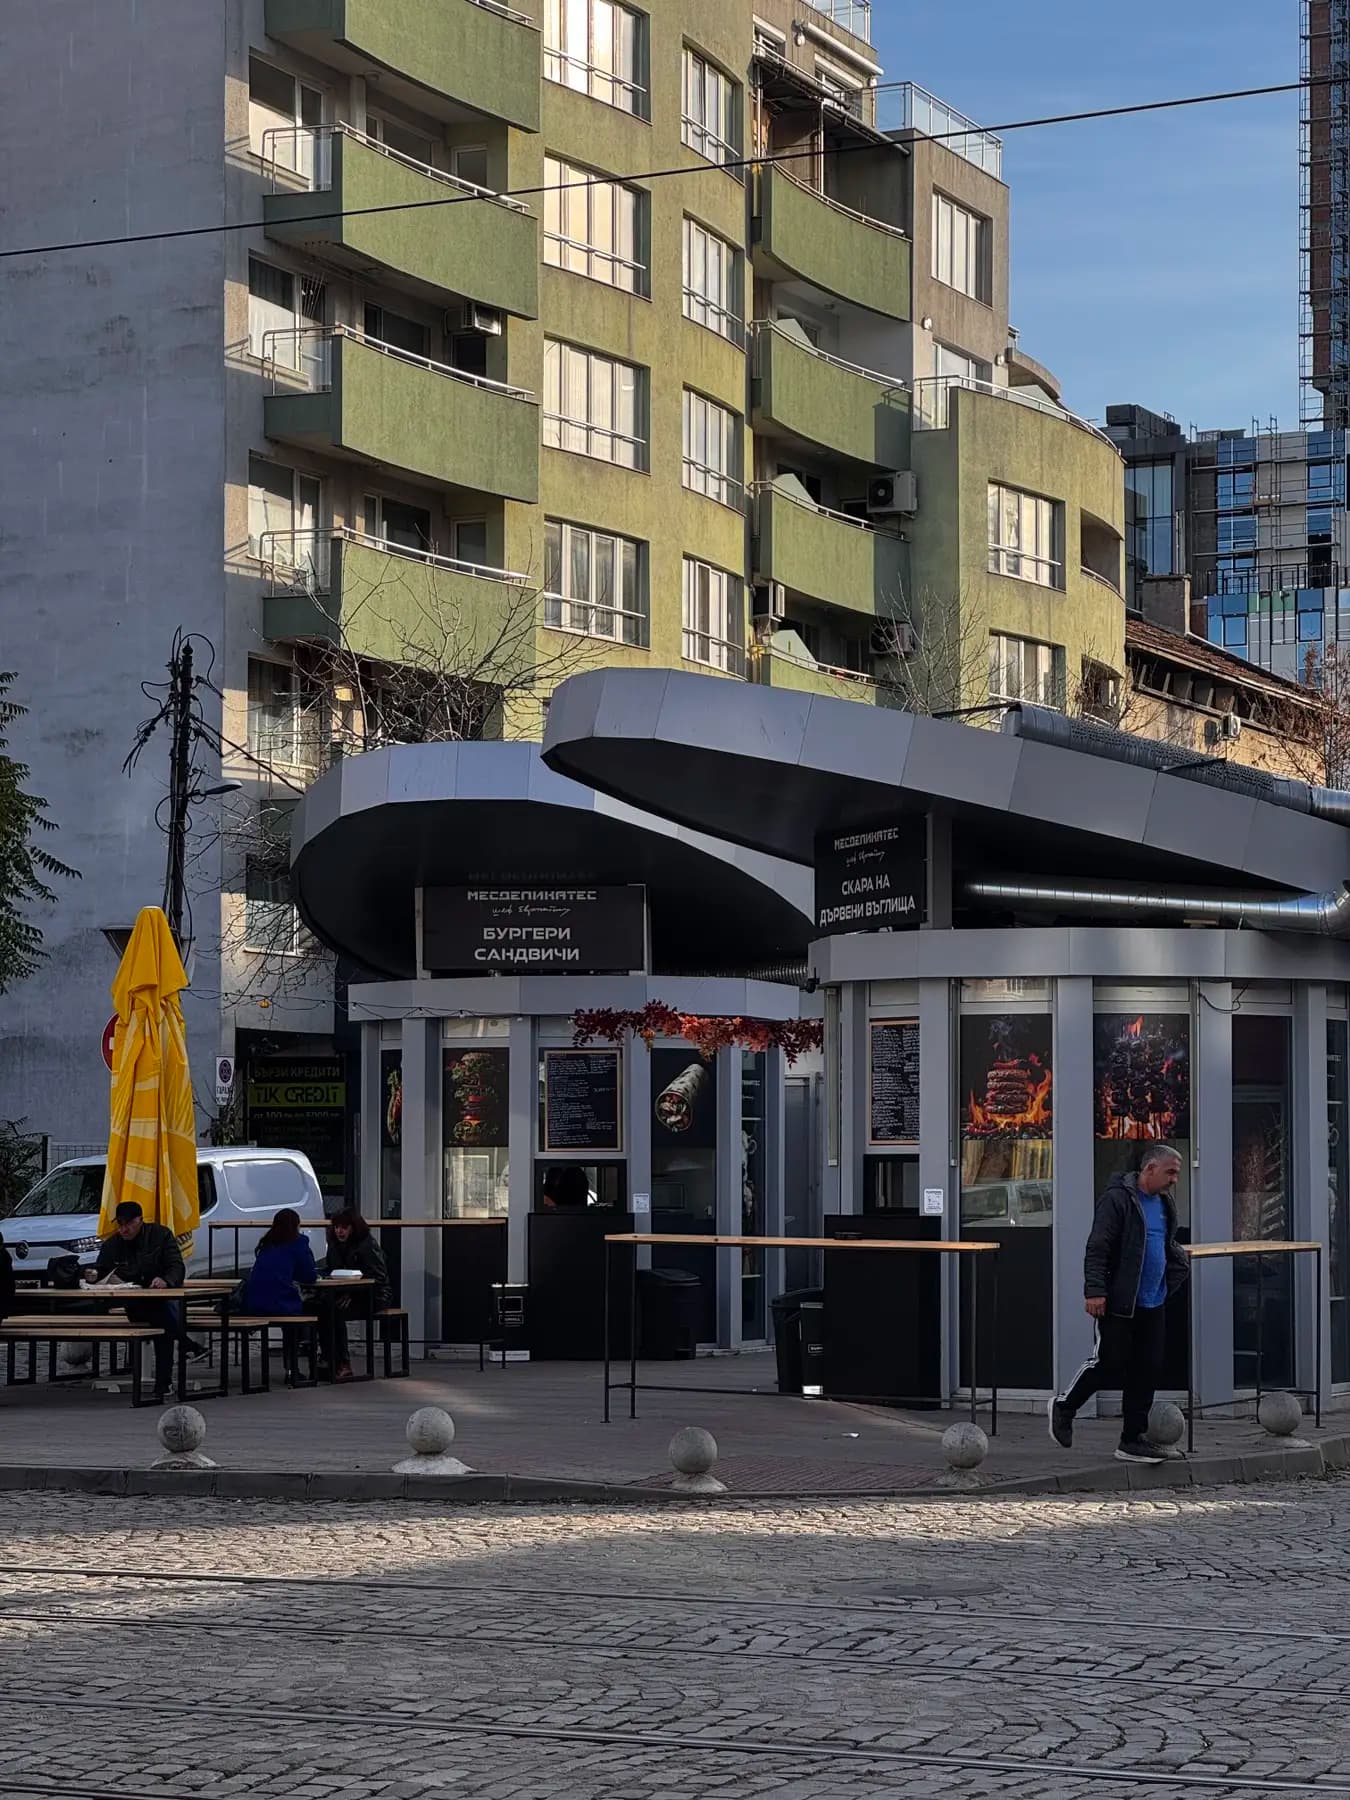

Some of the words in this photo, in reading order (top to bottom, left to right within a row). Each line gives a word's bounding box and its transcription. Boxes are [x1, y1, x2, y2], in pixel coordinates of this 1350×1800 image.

[841, 876, 874, 897] СКАРА
[875, 873, 891, 890] НА
[819, 903, 865, 928] ДЪРВЕНИ
[865, 894, 916, 917] ВЪГЛИЩА
[483, 927, 571, 941] БУРГЕРИ
[474, 948, 580, 964] САНДВИЧИ
[290, 1065, 341, 1080] КРЕДИТИ
[284, 1086, 341, 1104] CREDIT
